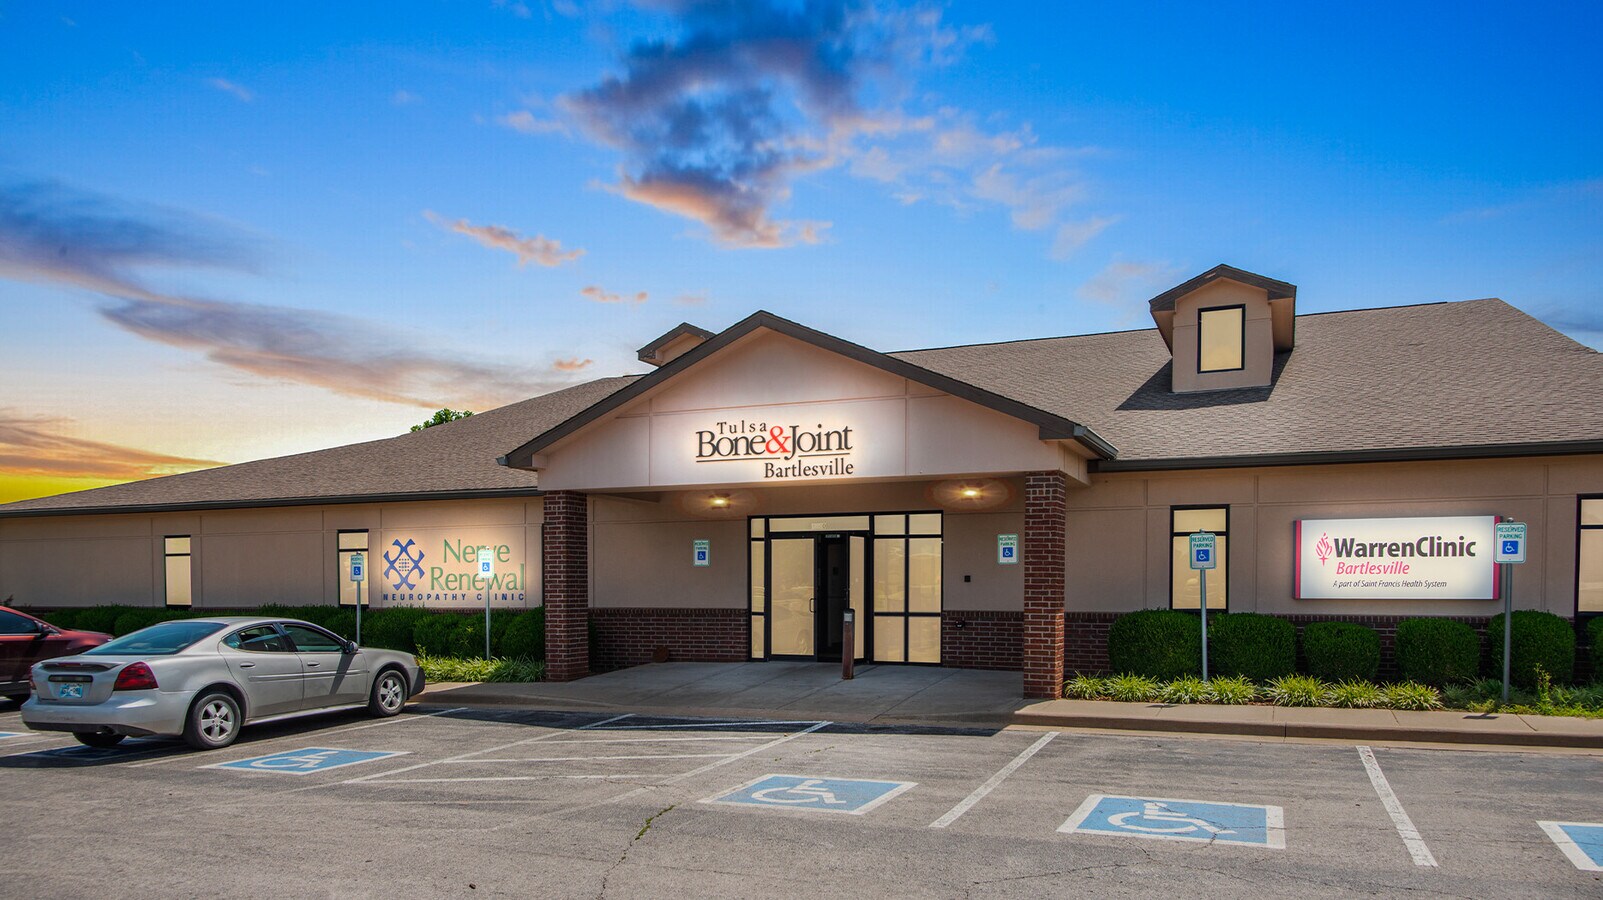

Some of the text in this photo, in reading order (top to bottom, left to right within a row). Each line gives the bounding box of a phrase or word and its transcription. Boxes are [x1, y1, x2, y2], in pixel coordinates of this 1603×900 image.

[716, 420, 767, 434] Tulsa
[696, 423, 853, 460] Bone&Joint
[764, 458, 854, 478] Bartlesville
[443, 538, 511, 563] Nere
[1334, 535, 1477, 558] WarrenClinic
[1336, 561, 1410, 575] Bartlesville
[1338, 581, 1352, 589] part
[1424, 580, 1447, 589] System
